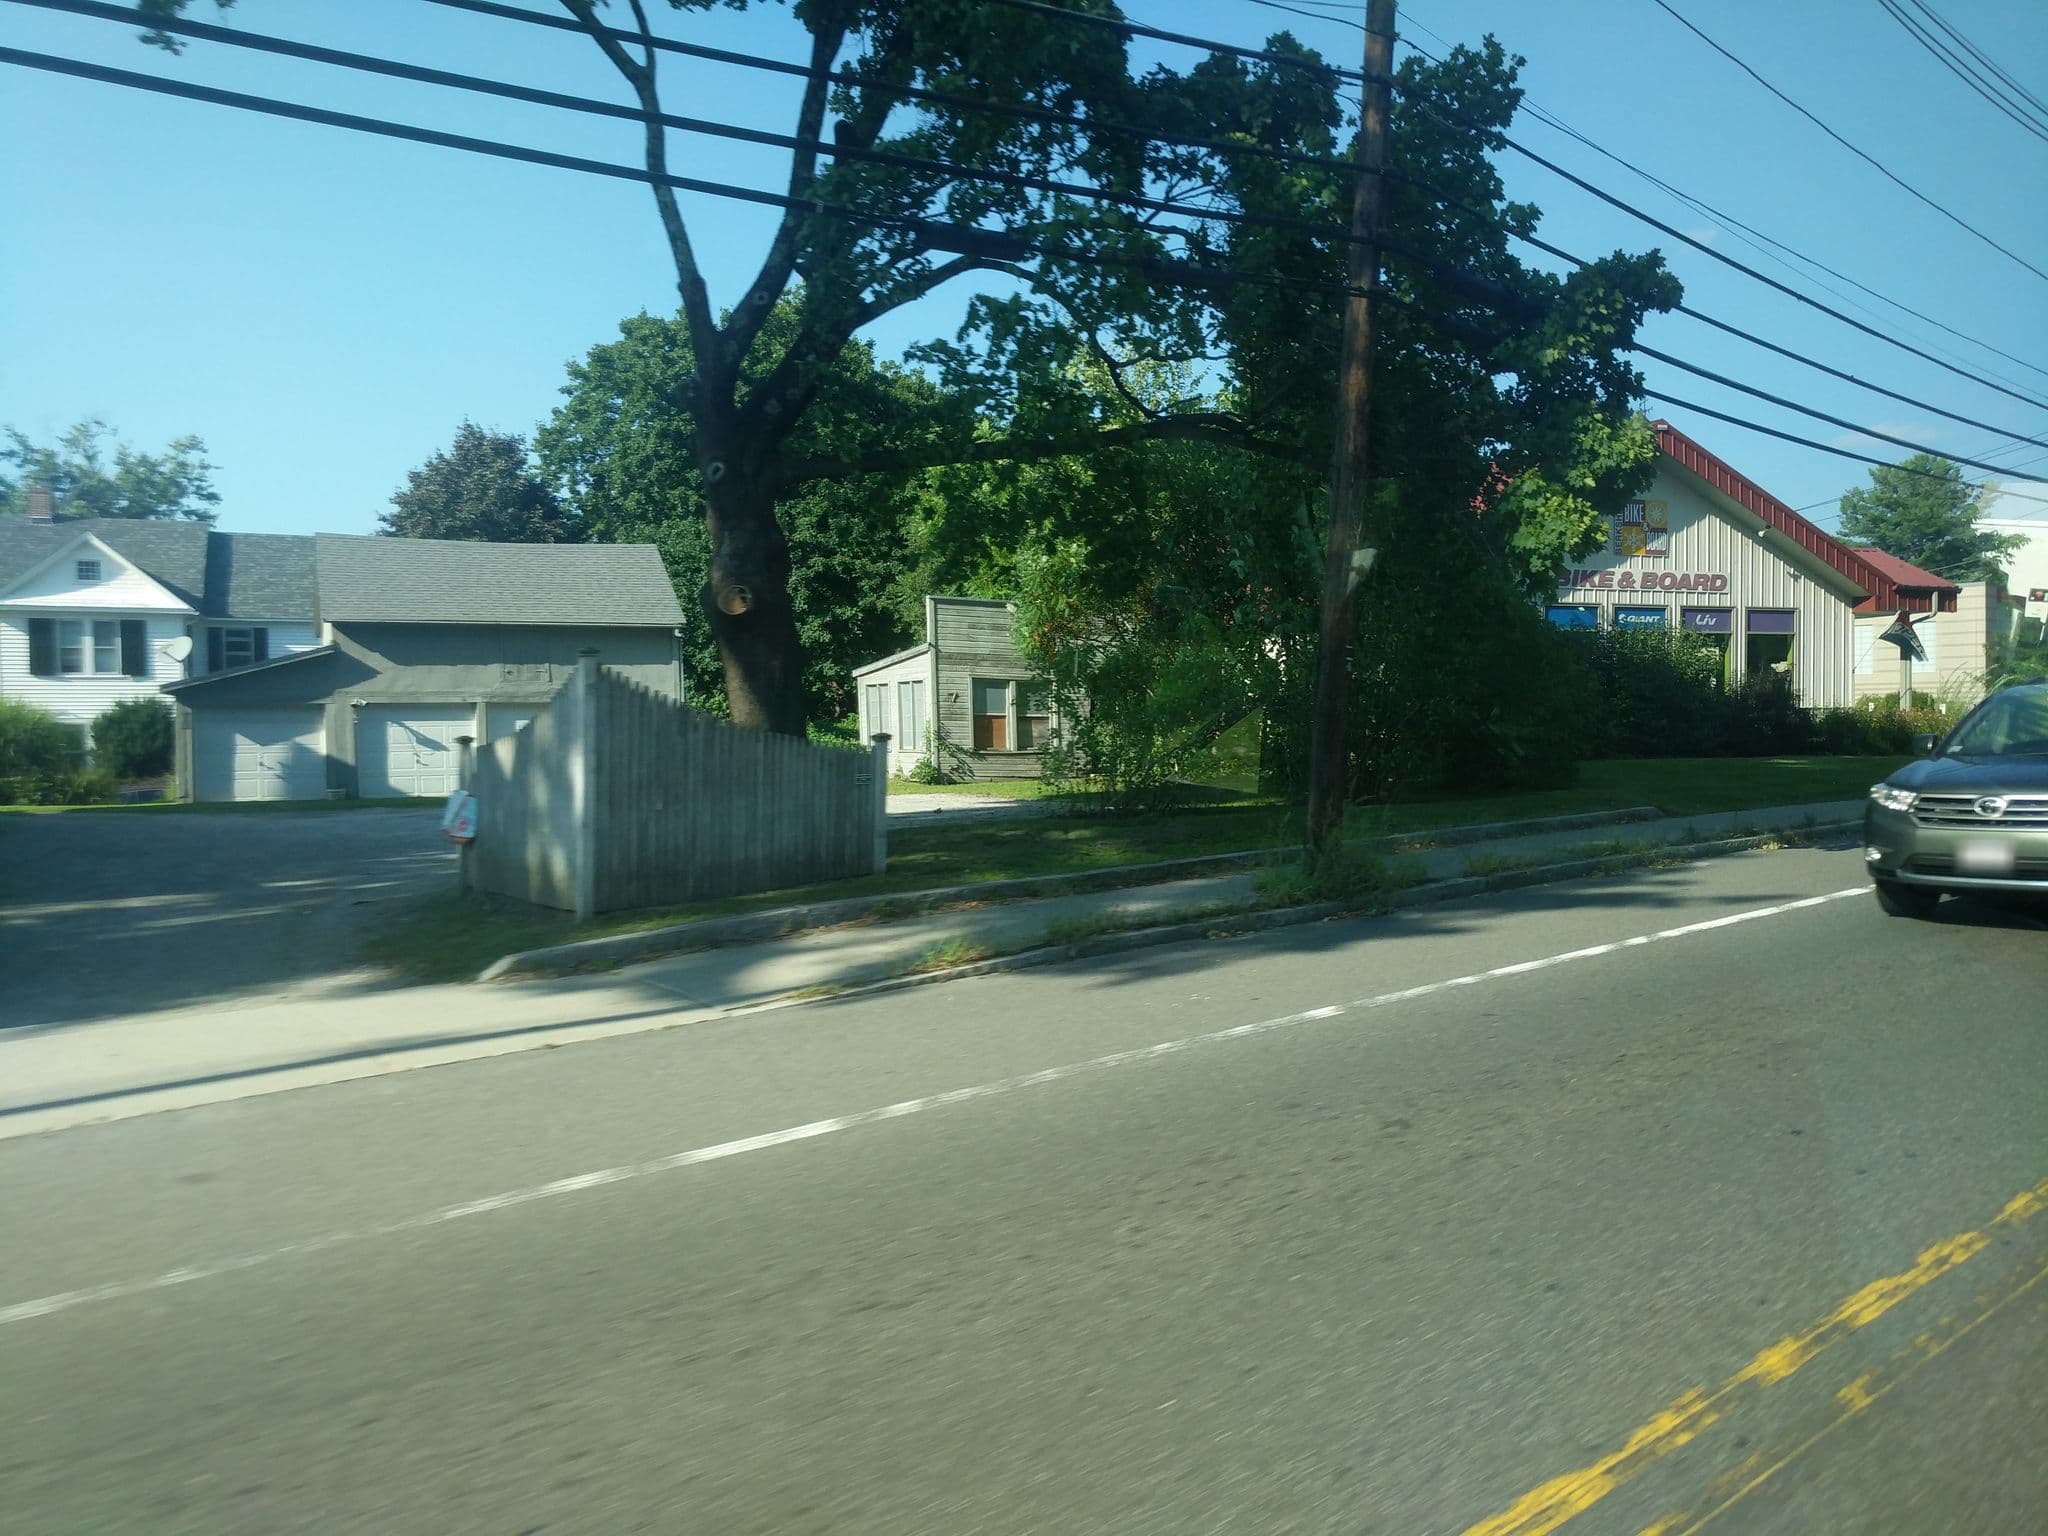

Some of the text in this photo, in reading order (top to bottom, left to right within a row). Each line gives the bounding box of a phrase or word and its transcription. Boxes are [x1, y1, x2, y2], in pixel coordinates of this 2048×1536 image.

[1624, 504, 1644, 522] BIKE
[1646, 532, 1667, 550] BOARD
[1617, 571, 1636, 588] &
[1640, 571, 1728, 591] BOARD
[1626, 615, 1661, 623] GIANT
[1695, 614, 1717, 626] Liv
